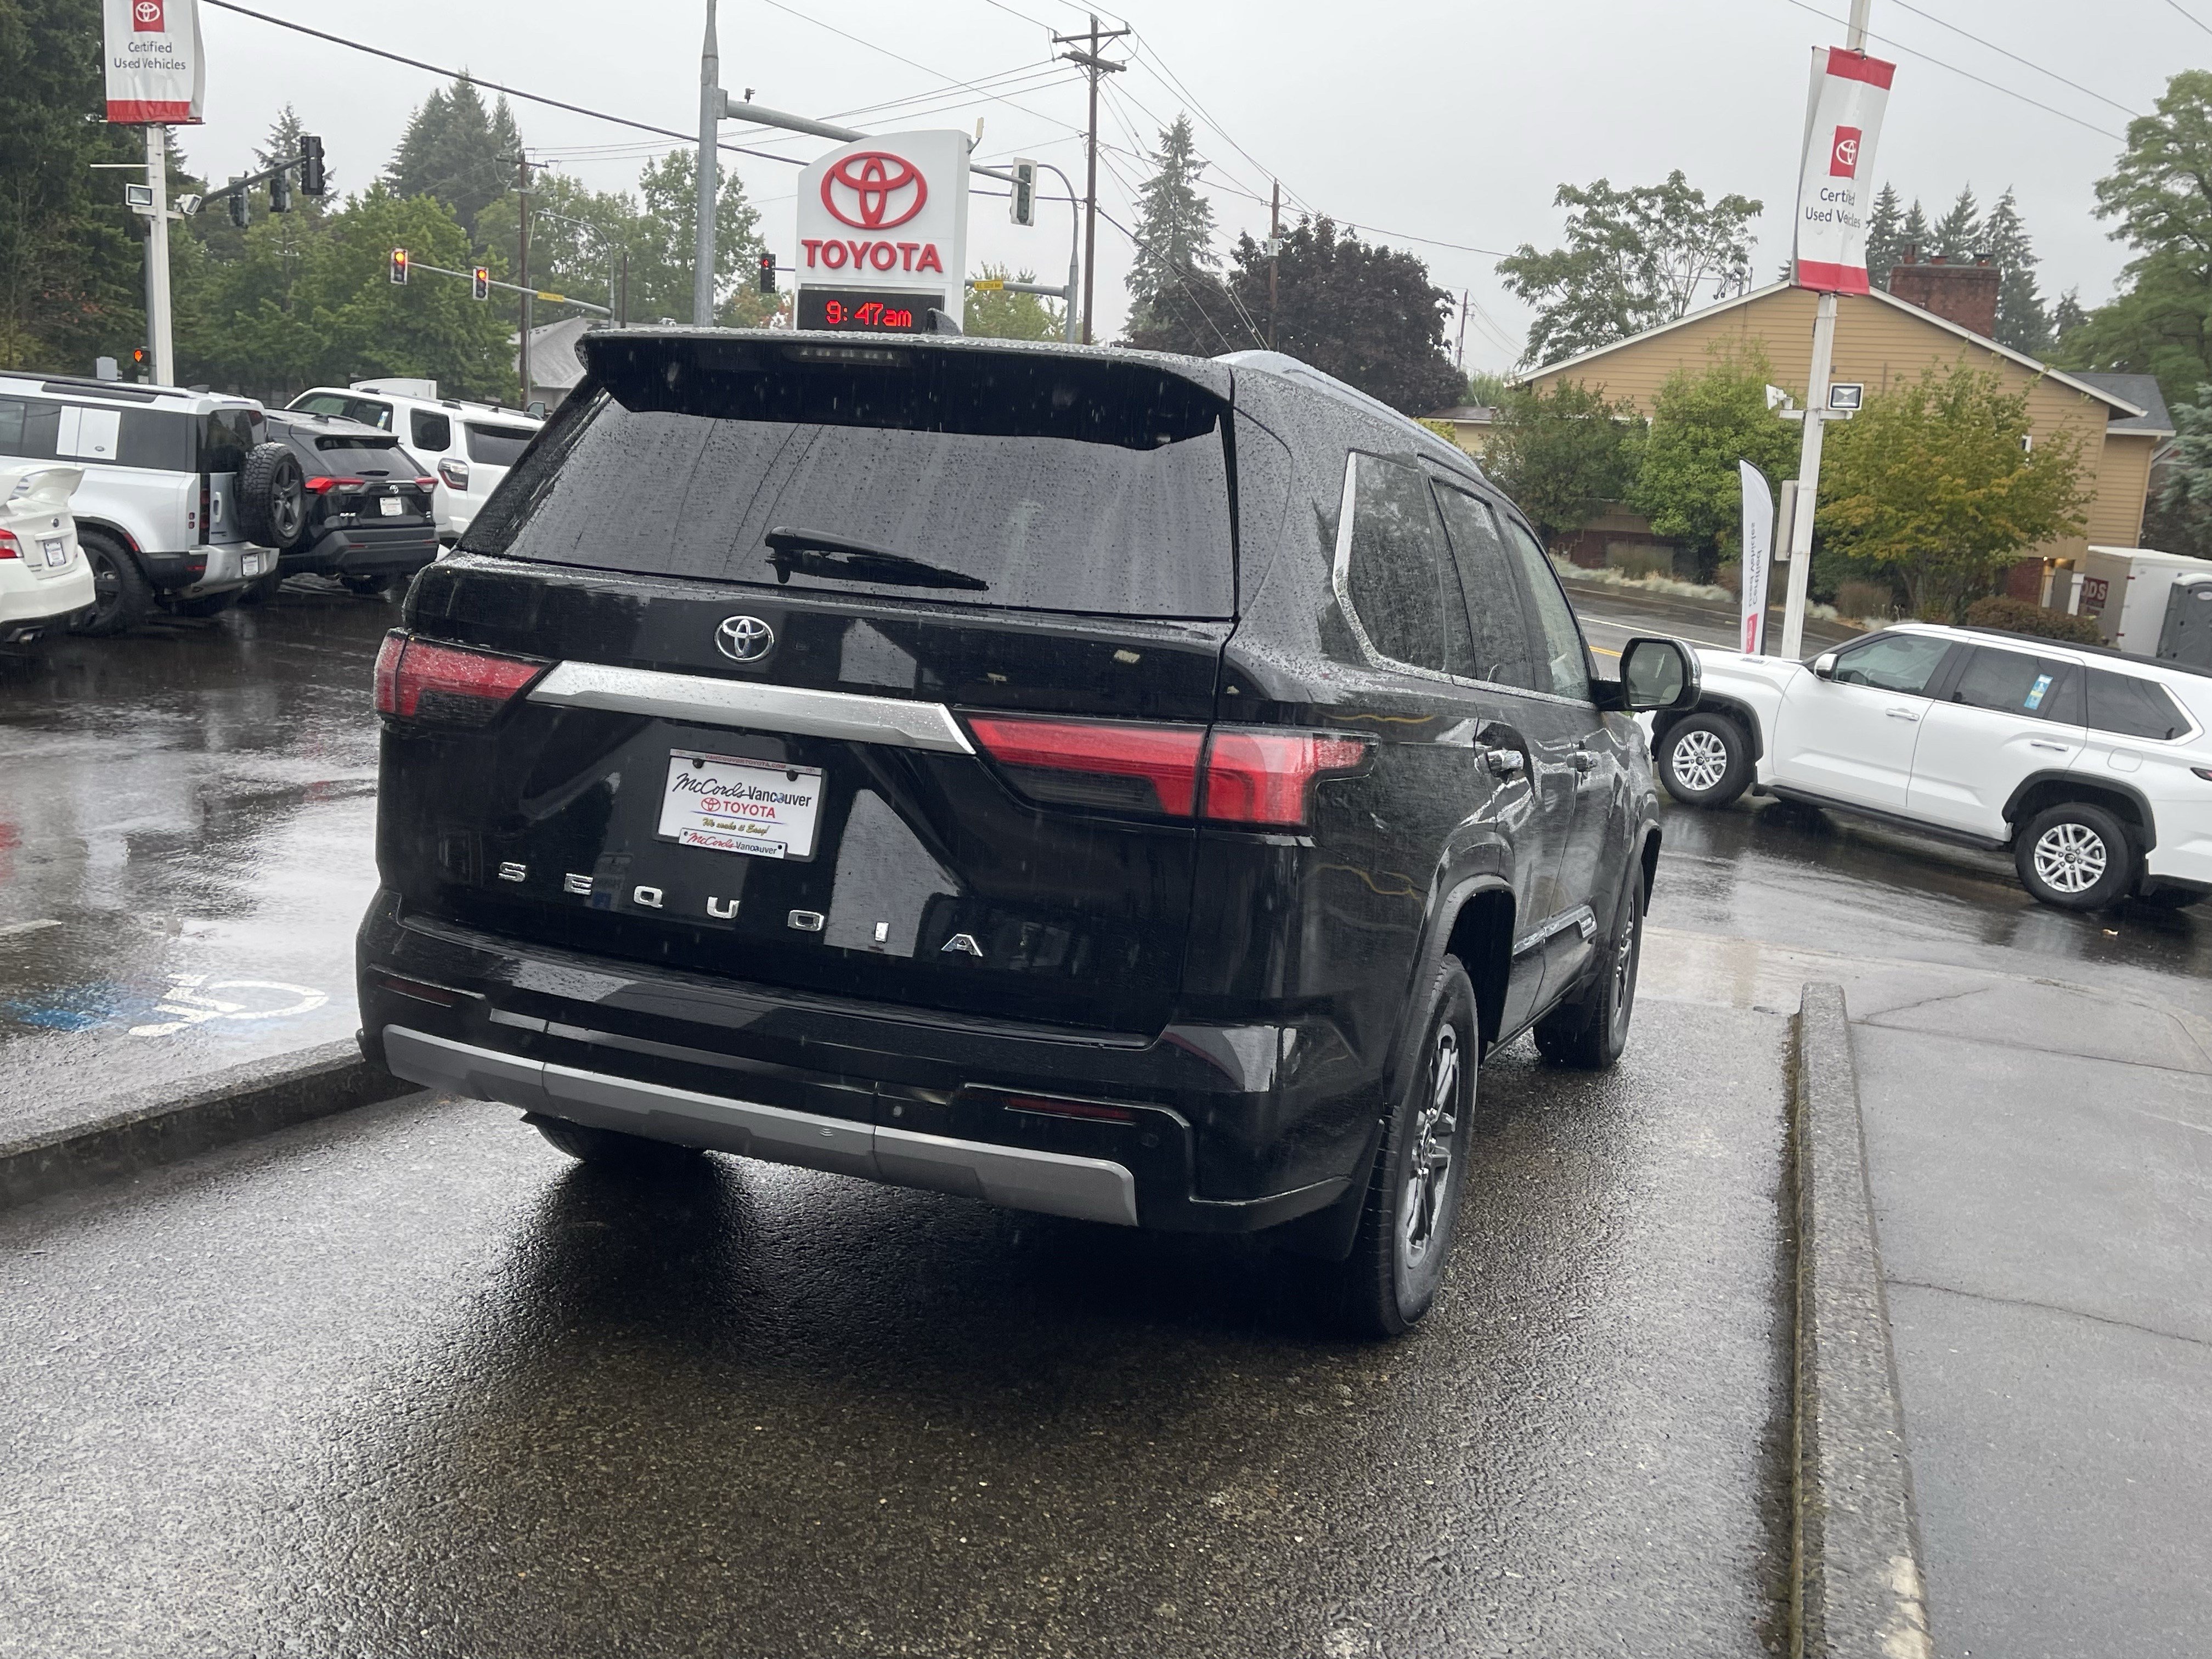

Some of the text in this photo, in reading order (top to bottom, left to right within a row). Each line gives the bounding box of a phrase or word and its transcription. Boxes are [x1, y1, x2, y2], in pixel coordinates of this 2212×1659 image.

[128, 41, 172, 53] Certified
[114, 58, 186, 70] Used Vehicles
[1820, 187, 1856, 206] Certied
[1805, 206, 1861, 229] Used Vecles
[801, 239, 943, 274] TOYOTA
[826, 300, 912, 328] 9:47am
[2081, 580, 2106, 600] ODS
[723, 800, 776, 819] TOYOTA
[498, 861, 984, 957] SEQUOIA
